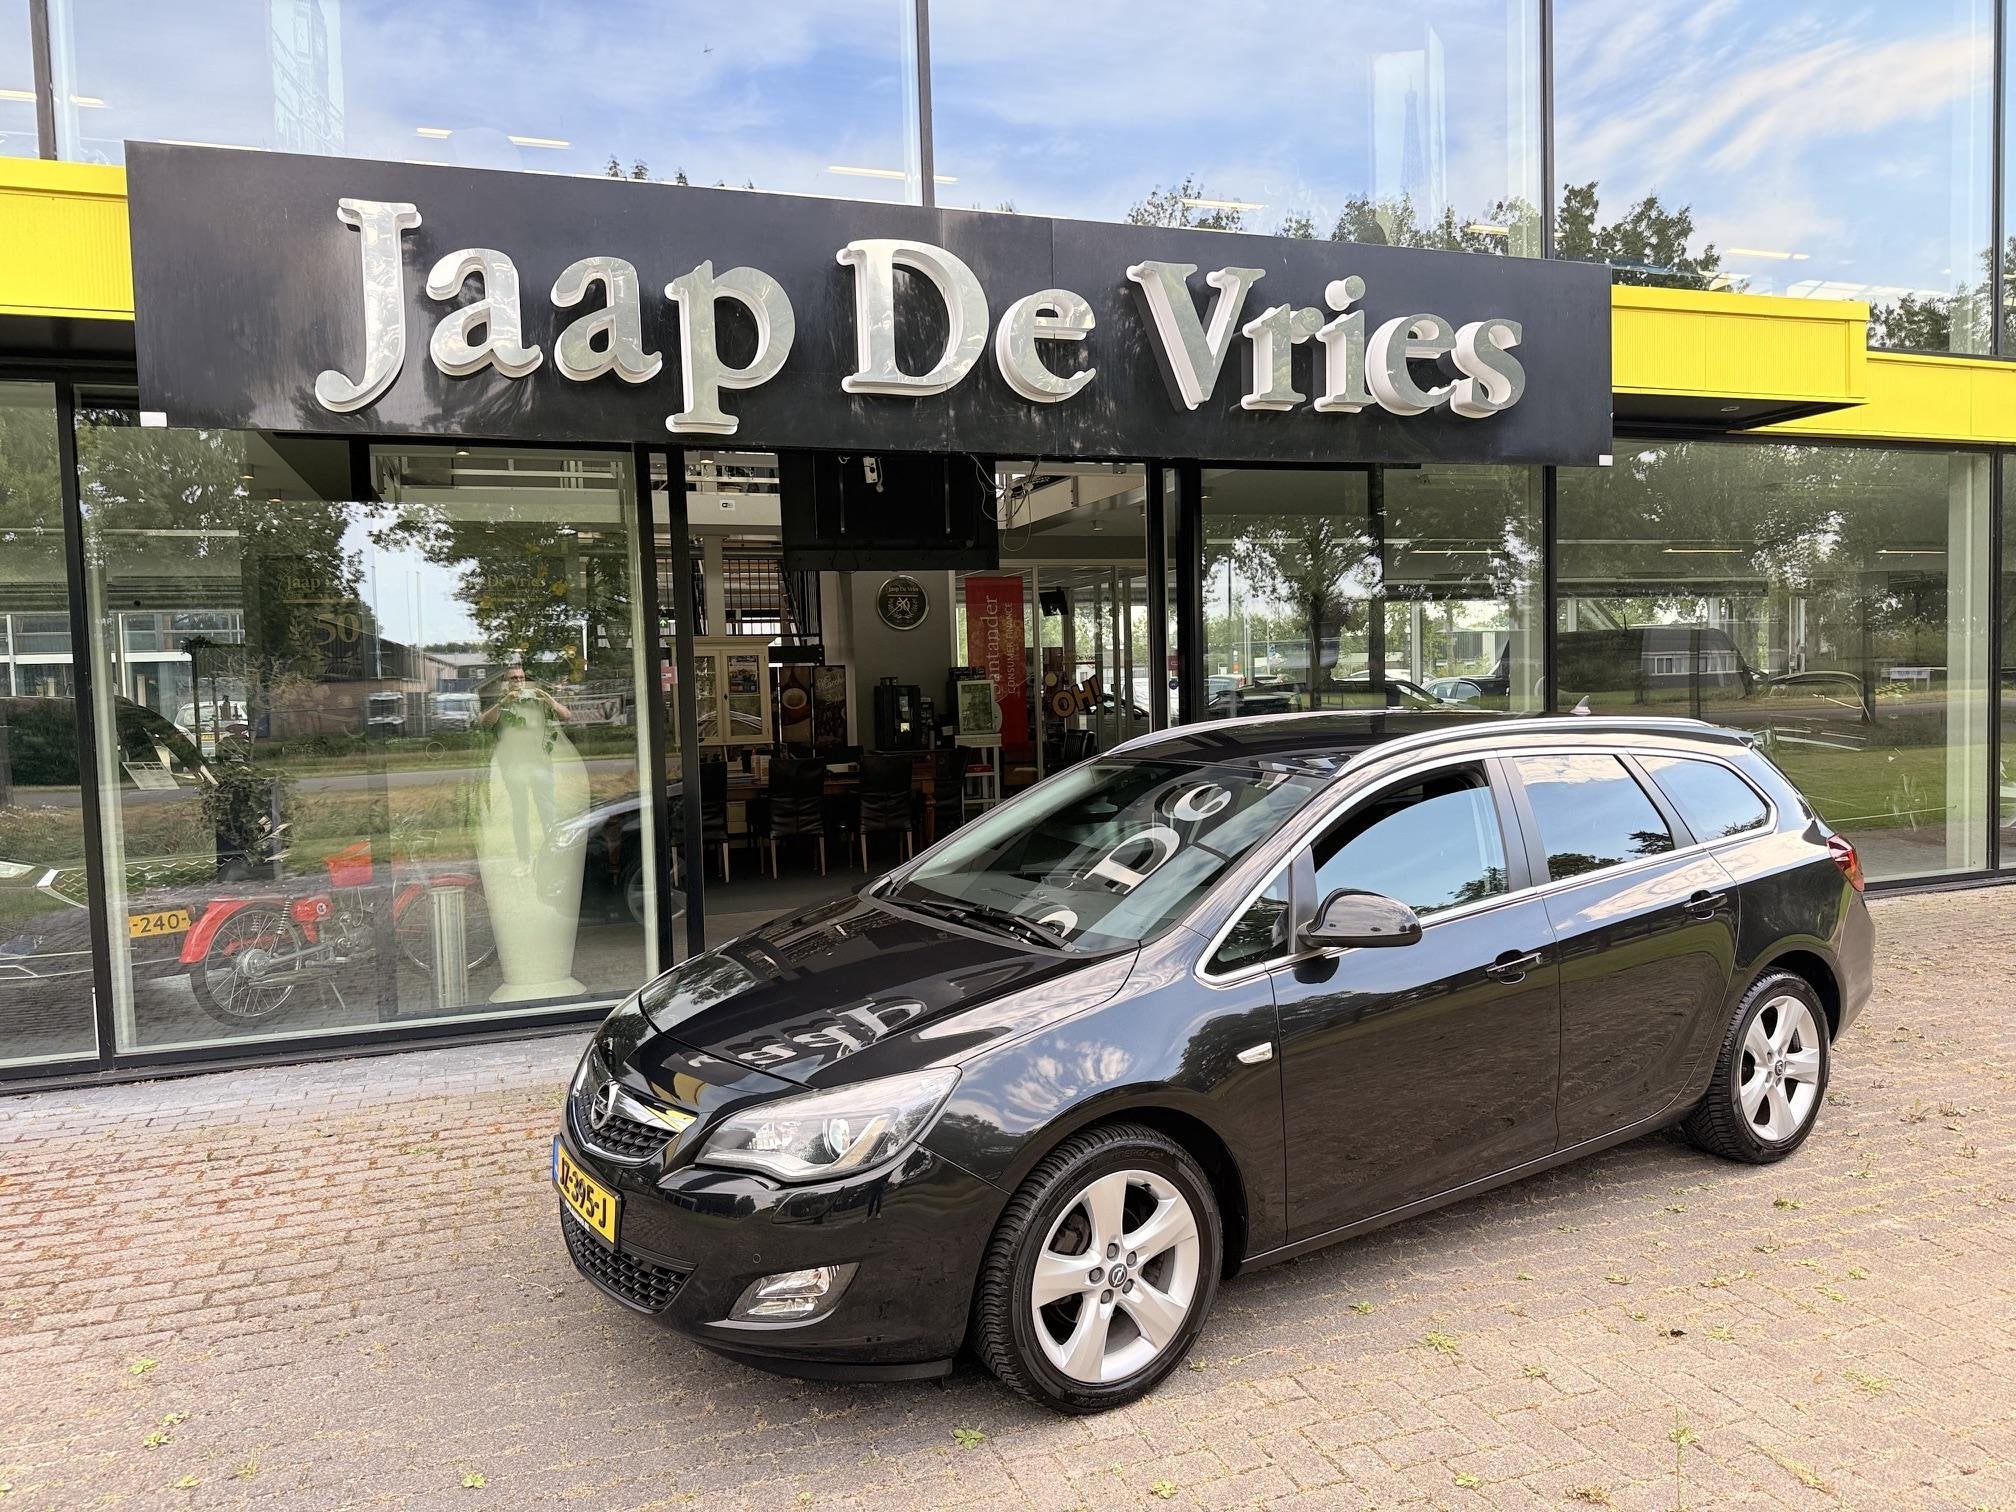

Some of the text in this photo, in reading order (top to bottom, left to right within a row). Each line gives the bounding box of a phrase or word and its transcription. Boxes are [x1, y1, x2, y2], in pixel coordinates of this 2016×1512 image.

[314, 197, 1527, 436] Jaap De Vries
[1004, 602, 1016, 694] CONSUMER FINANCE
[1052, 675, 1103, 718] OH!
[128, 913, 191, 934] -240-
[560, 1156, 607, 1228] JZ-395-J
